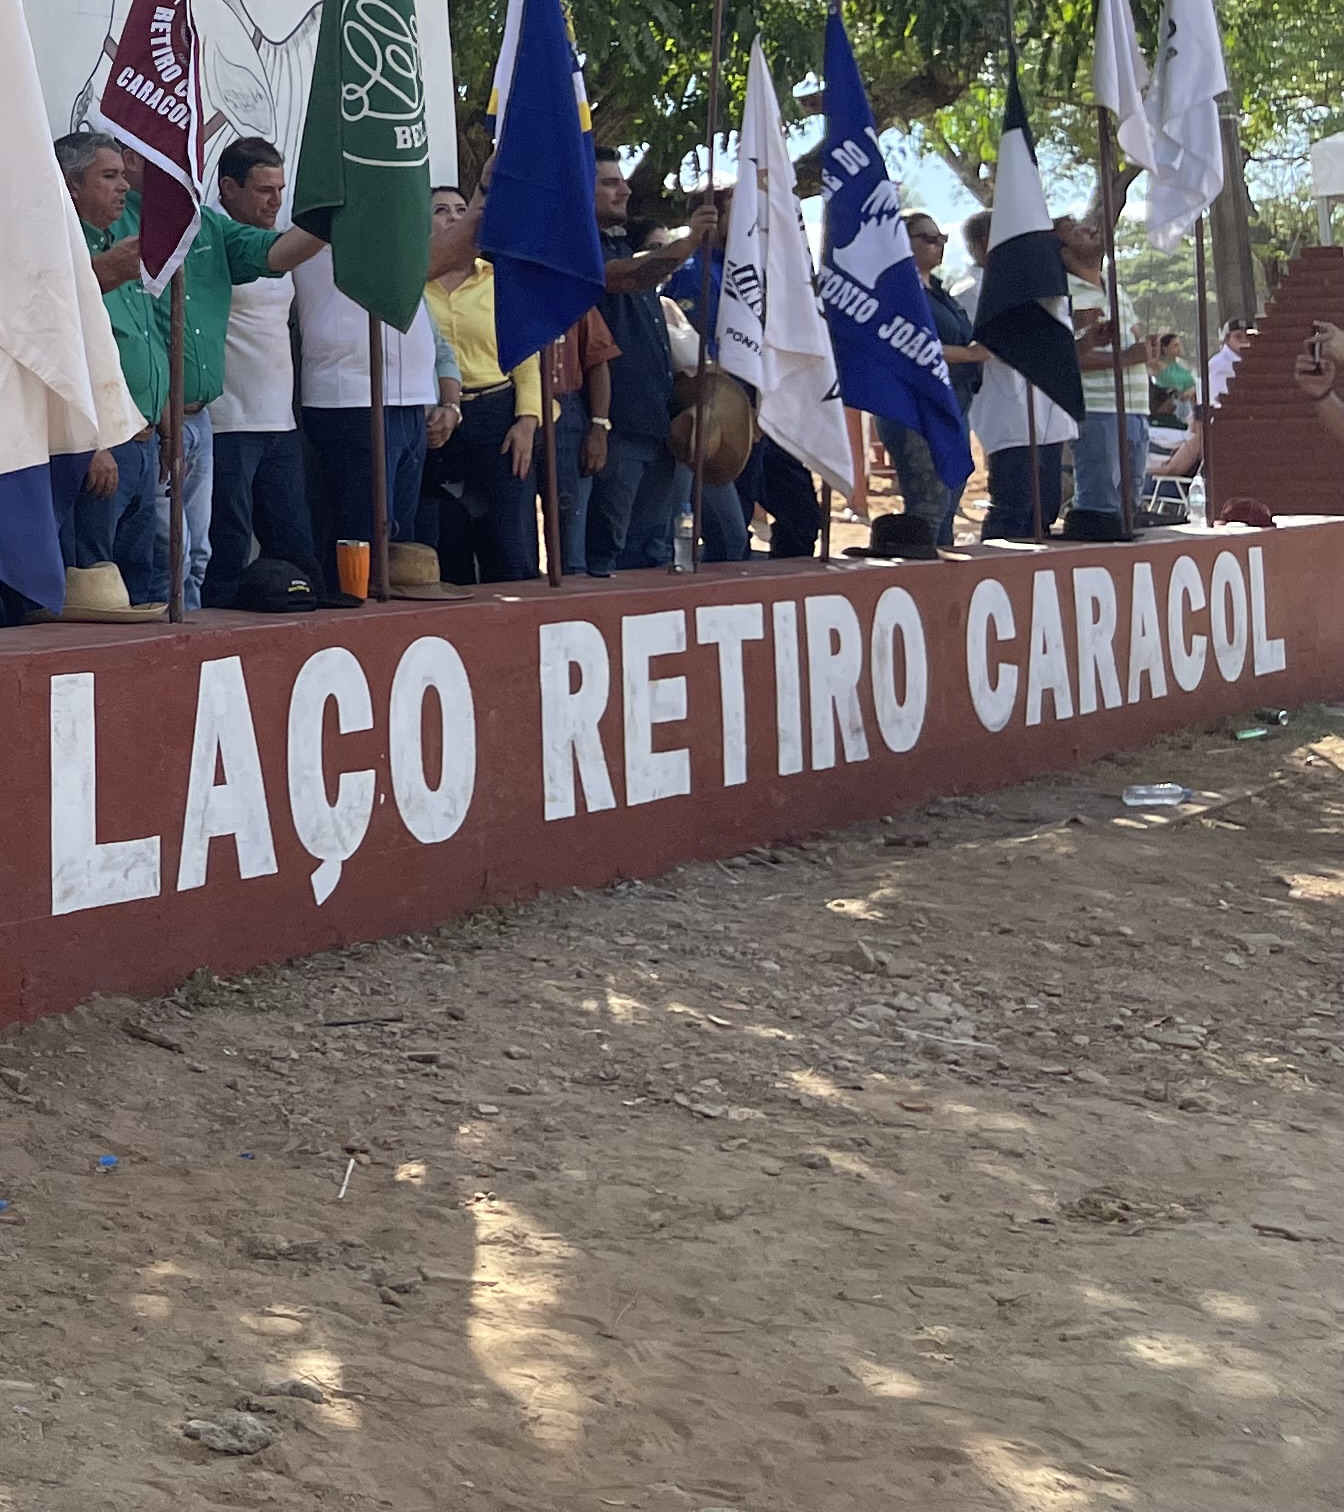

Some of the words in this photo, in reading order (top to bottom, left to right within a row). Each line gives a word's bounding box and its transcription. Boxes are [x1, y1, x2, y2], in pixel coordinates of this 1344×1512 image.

[150, 6, 183, 84] RETIRO
[831, 139, 871, 177] DO
[50, 635, 478, 907] LAÇO
[538, 586, 928, 822] RETIRO
[966, 545, 1288, 733] CARACOL
